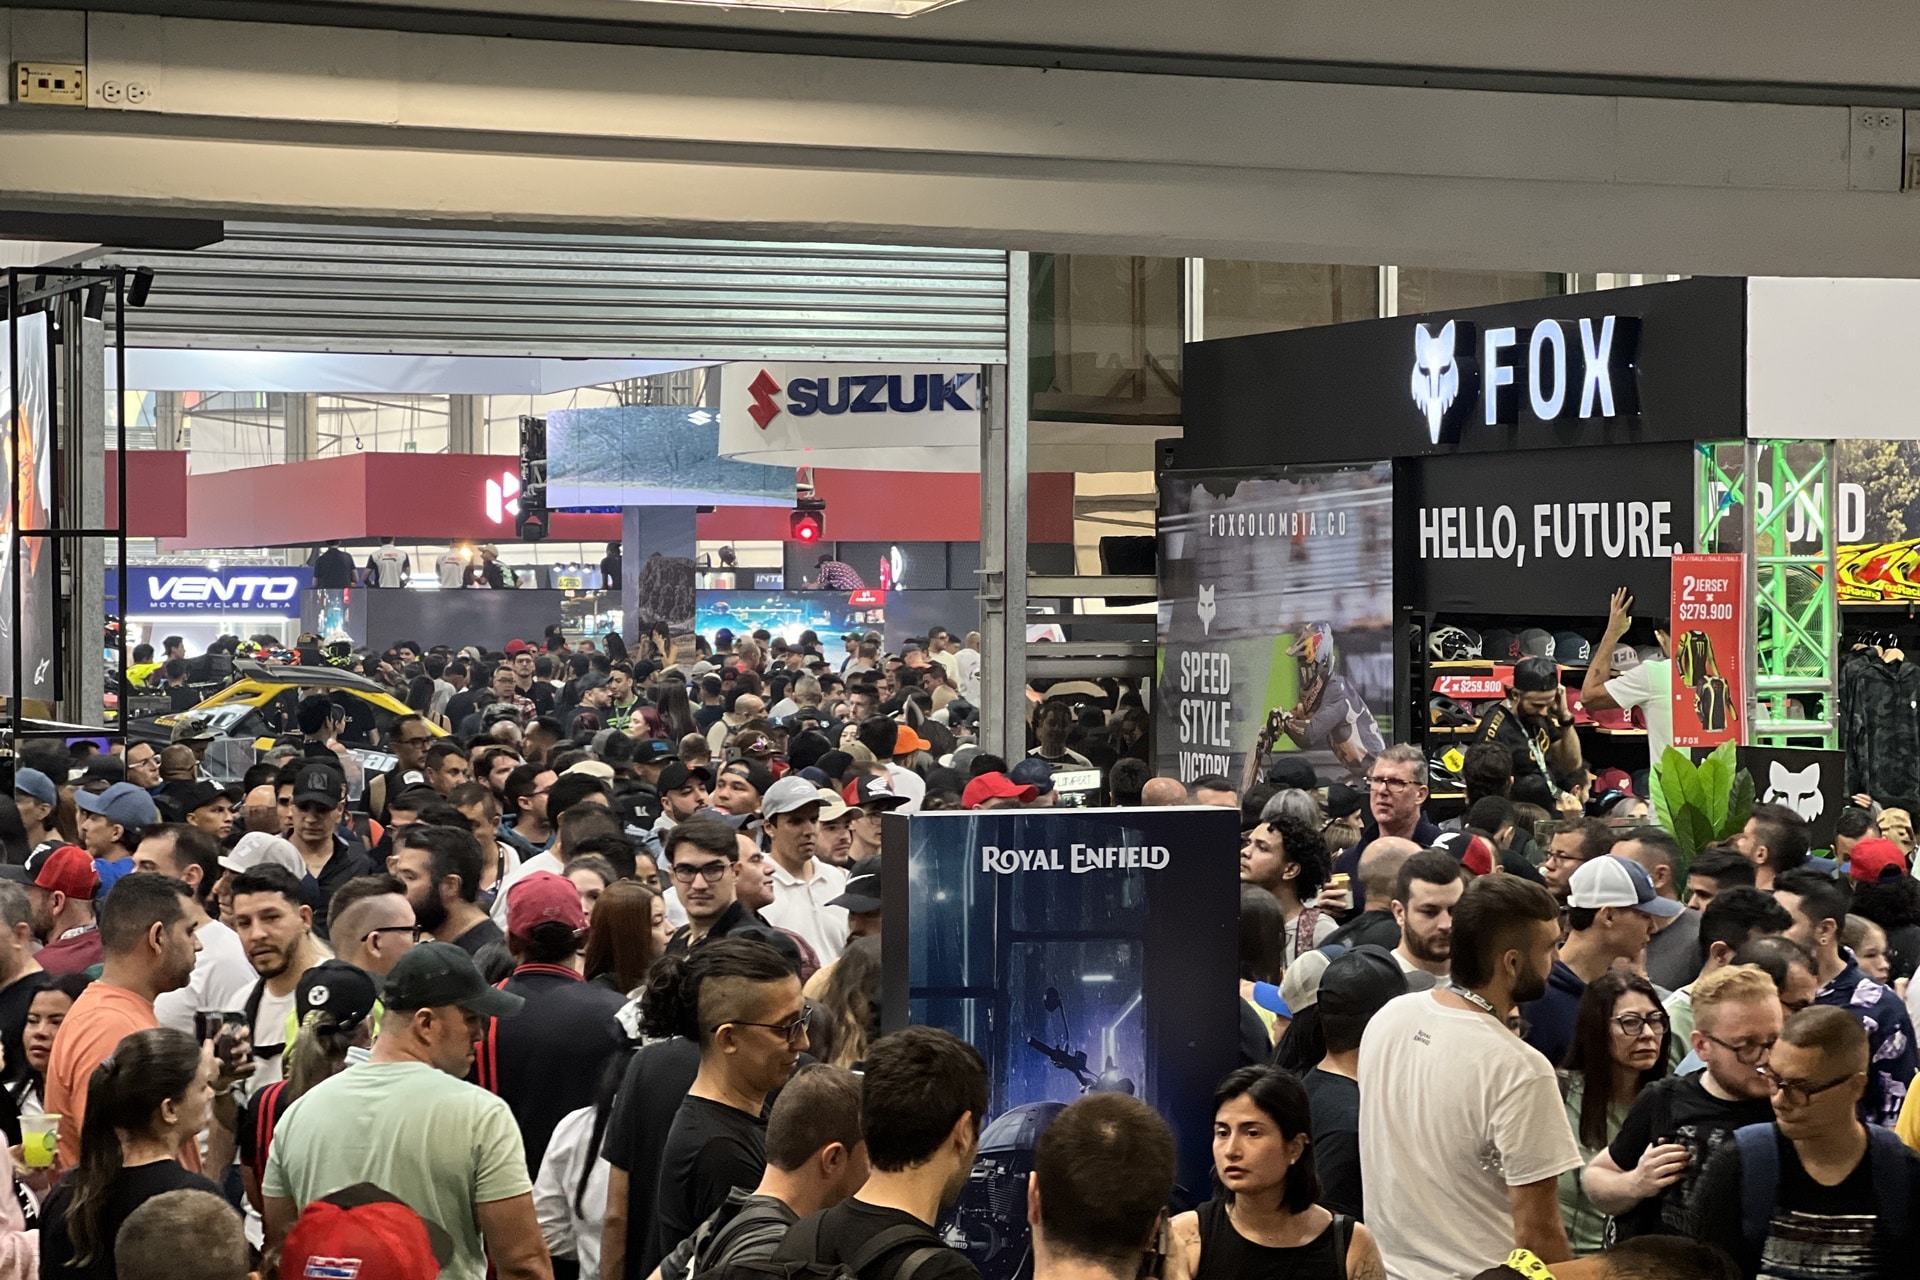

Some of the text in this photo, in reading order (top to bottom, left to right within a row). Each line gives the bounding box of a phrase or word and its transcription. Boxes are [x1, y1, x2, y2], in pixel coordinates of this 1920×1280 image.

[1485, 315, 1616, 426] FOX
[787, 373, 981, 417] SUZUK
[1209, 511, 1346, 537] FOXCOLOMBIA.CO
[1419, 501, 1684, 568] HELLO, FUTURE.
[148, 576, 298, 601] VENTO
[1682, 575, 1729, 601] 2 JERSEY
[1679, 602, 1733, 622] $279.900
[1180, 650, 1231, 695] SPEED
[1460, 680, 1502, 693] $259.900
[1180, 698, 1231, 747] STYLE
[1682, 736, 1699, 745] FOX
[1179, 751, 1231, 783] VICTORY
[982, 843, 1170, 875] ROYAL ENFIELD
